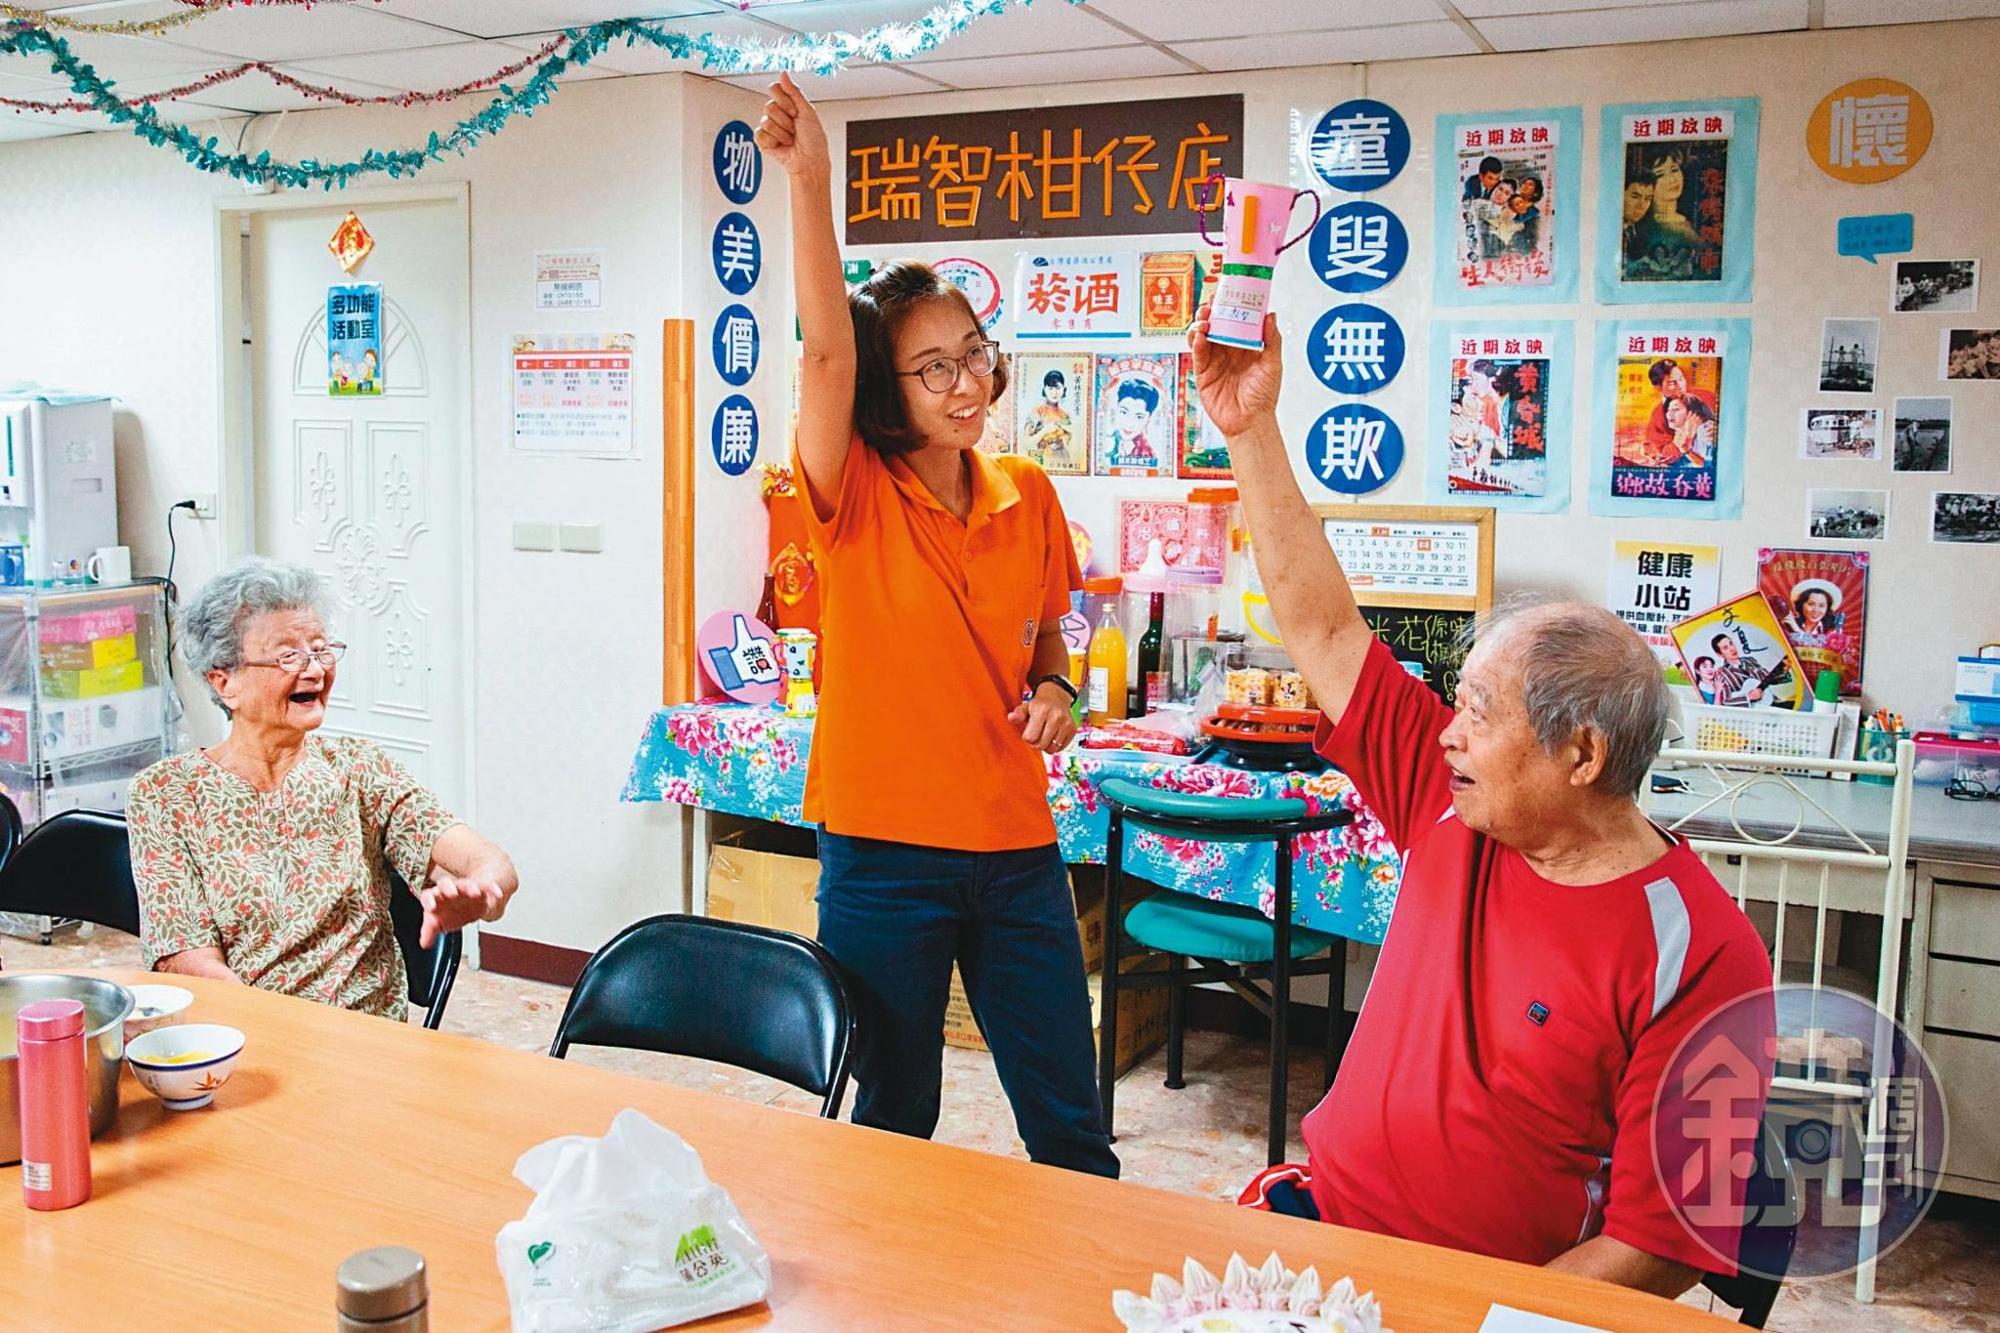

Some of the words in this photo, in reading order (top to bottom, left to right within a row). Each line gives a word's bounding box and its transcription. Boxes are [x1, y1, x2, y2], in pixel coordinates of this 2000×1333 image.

[1466, 127, 1549, 147] 近期放映
[1634, 117, 1723, 137] 近期放映
[1829, 94, 1909, 168] 懷
[847, 122, 1230, 229] 瑞智柑仔店
[332, 293, 375, 315] 多功能
[1027, 272, 1120, 315] 菸酒
[332, 319, 375, 340] 活動室
[1462, 339, 1543, 355] 近期放映
[1629, 336, 1716, 353] 近期放映
[1637, 551, 1693, 578] 健康
[1634, 584, 1691, 611] 小站
